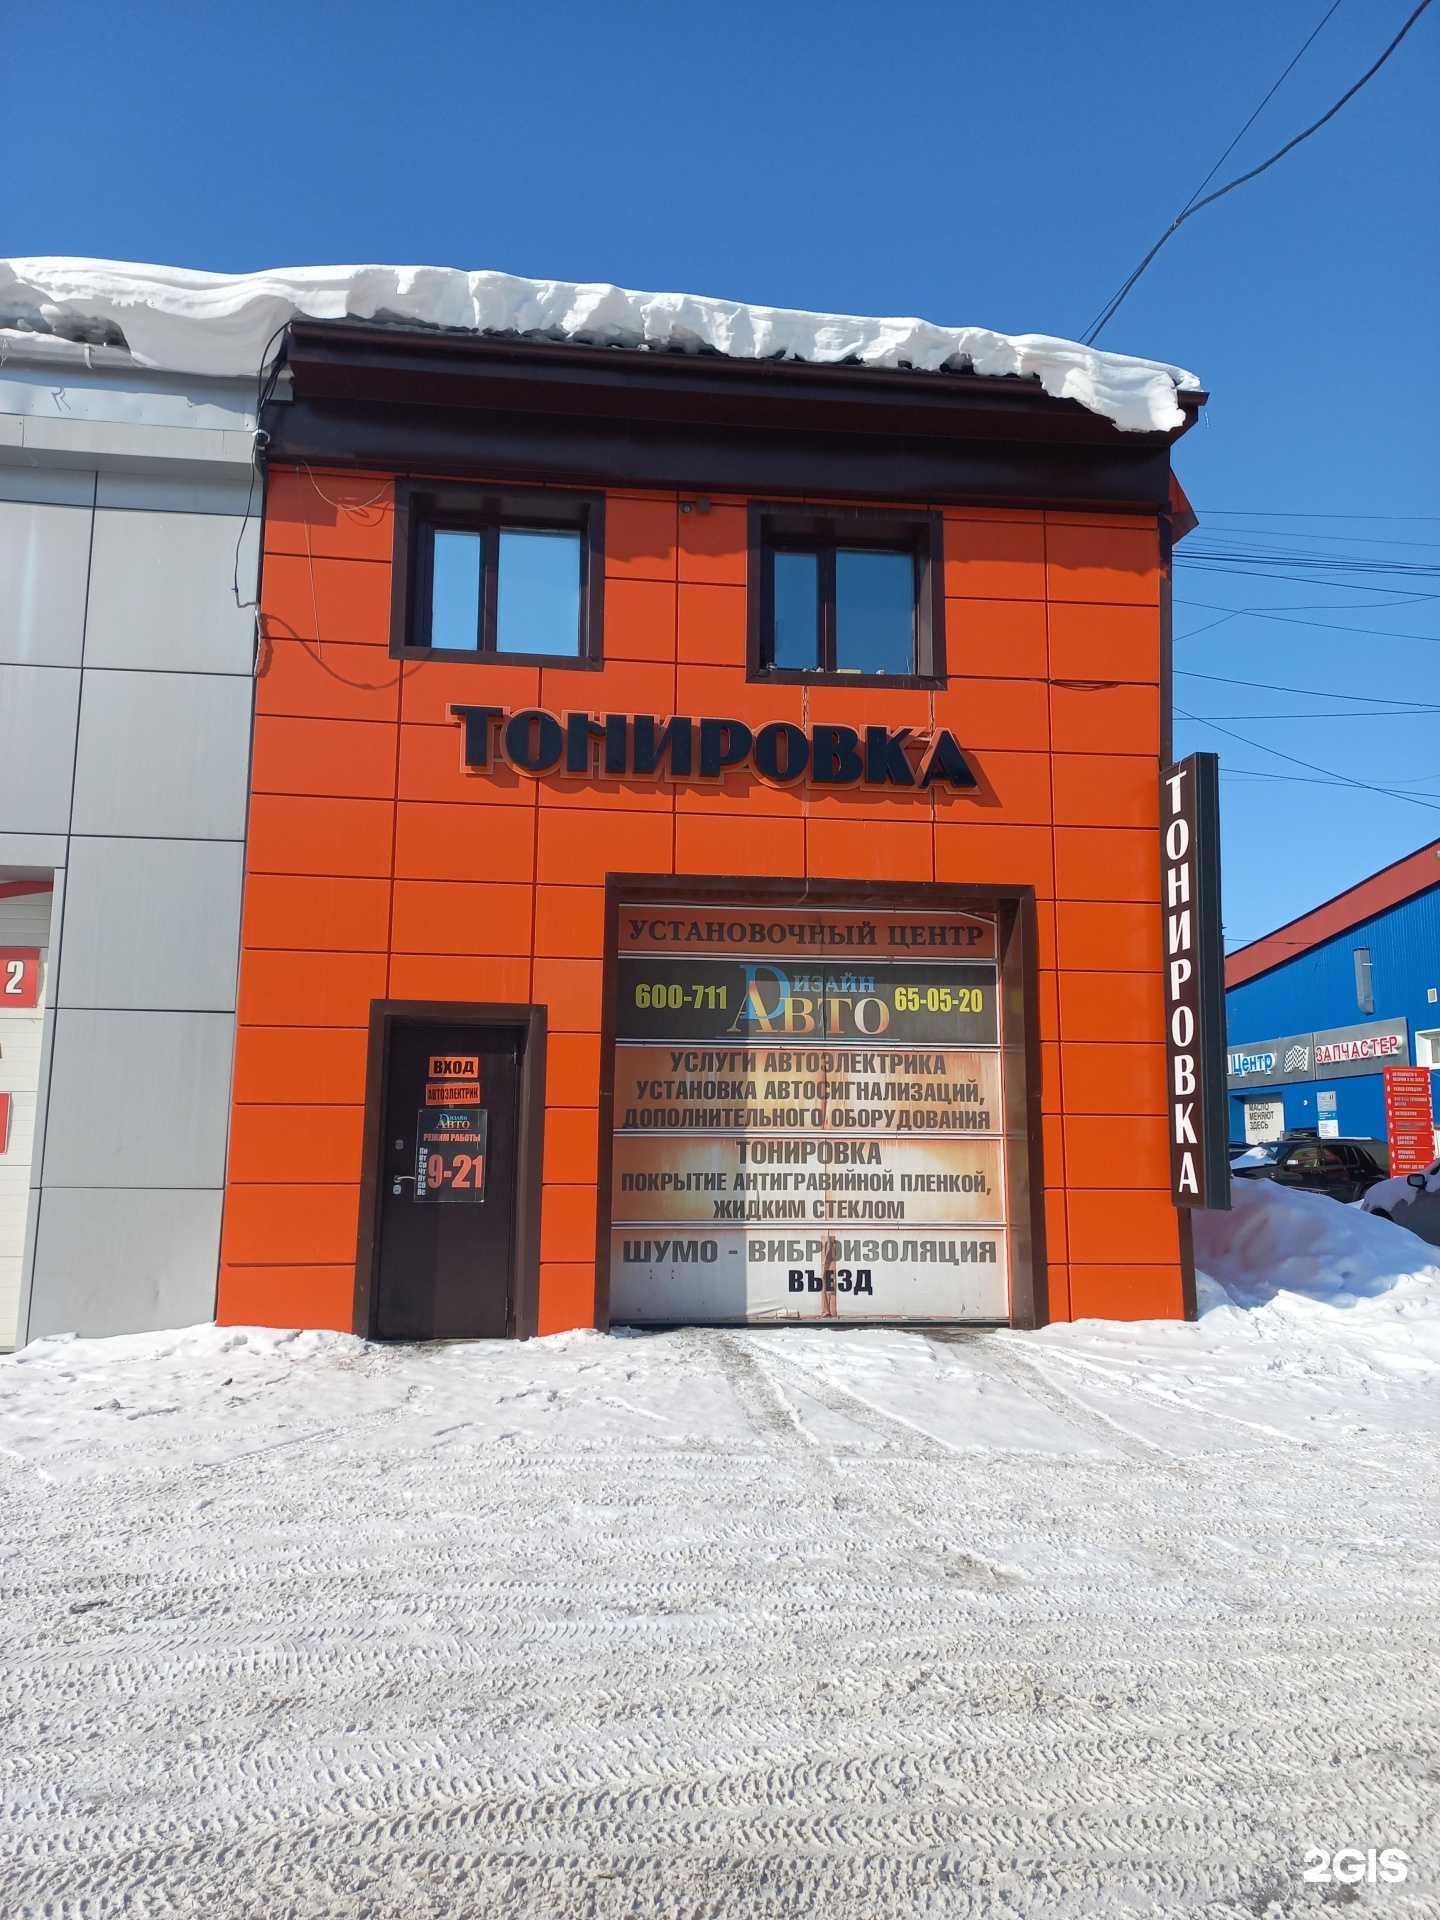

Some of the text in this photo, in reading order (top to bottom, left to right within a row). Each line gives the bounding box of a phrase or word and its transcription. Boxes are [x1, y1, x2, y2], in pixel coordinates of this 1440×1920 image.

[449, 704, 979, 788] ТОНИРОВКА
[628, 917, 984, 950] УСТАНОВОЧНЫЙ ЦЕНТР
[5, 960, 24, 994] 2
[1165, 770, 1199, 1195] ТОНИРОВКА
[634, 983, 729, 1010] 600-711
[726, 982, 890, 1035] АВТО
[894, 987, 983, 1013] 65-05-20
[670, 1051, 946, 1075] УСЛУГИ АВТОЭЛЕКТРИКА
[1315, 1036, 1398, 1063] ЗАПЧАСТЕР
[433, 1060, 475, 1075] ВХОД
[1232, 1053, 1275, 1077] Центр
[427, 1087, 479, 1100] АВТОЭЛЕКТРИК
[635, 1078, 986, 1106] УСТАНОВКА АВТОСИГНАЛИЗАЦИЙ,
[622, 1107, 991, 1132] ДОПОЛНИТЕЛЬНОГО ОБОРУДОВАНИЯ
[1249, 1111, 1274, 1121] МЕНЯЮТ
[1249, 1121, 1269, 1131] ЗДЕСЬ
[450, 1133, 481, 1142] РАБОТЫ
[735, 1141, 882, 1165] ТОНИРОВКА
[427, 1154, 483, 1189] 9-21
[621, 1168, 992, 1196] ПОКРЫТИЕ АНТИГРАВИЙНОЙ ПЛЕНКОЙ,
[712, 1199, 905, 1222] ЖИДКИМ СТЕКЛОМ
[623, 1239, 718, 1264] ШУМО
[748, 1239, 997, 1266] ВИБРОИЗОЛЯЦИЯ
[788, 1269, 873, 1296] ВЪЕЗД
